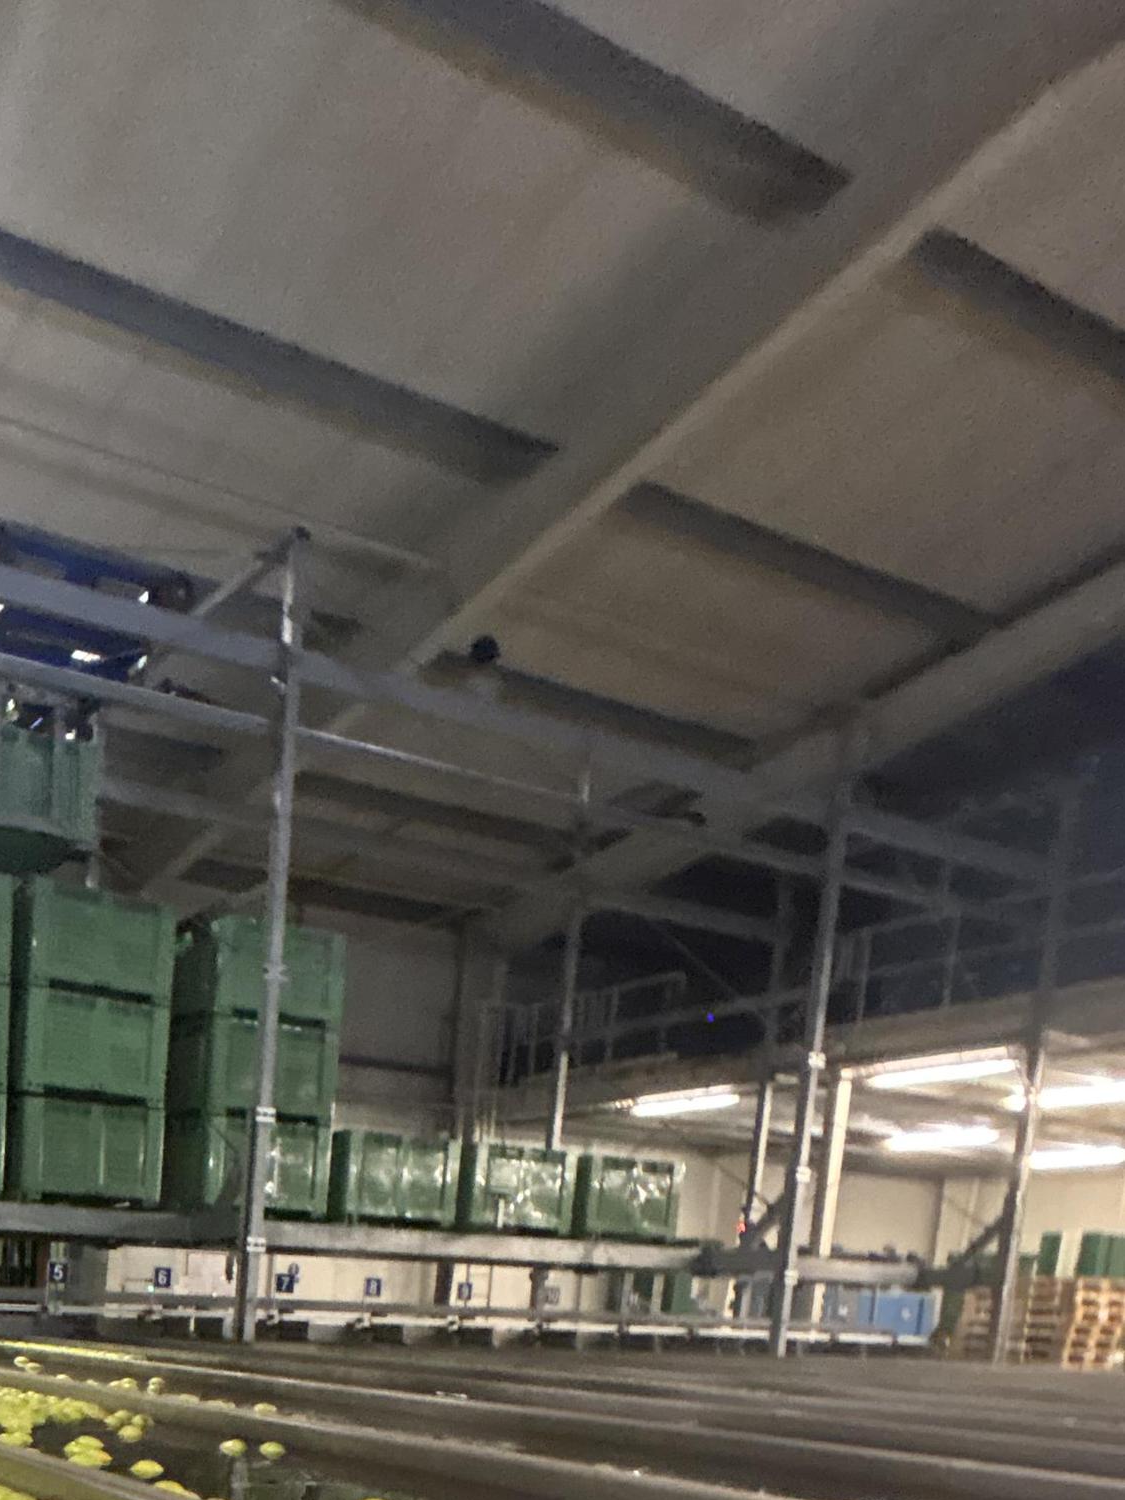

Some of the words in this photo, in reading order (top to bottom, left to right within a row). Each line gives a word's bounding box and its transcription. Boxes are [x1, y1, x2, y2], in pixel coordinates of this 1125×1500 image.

[53, 1264, 63, 1281] 5
[157, 1269, 167, 1286] 6
[281, 1276, 290, 1291] 7
